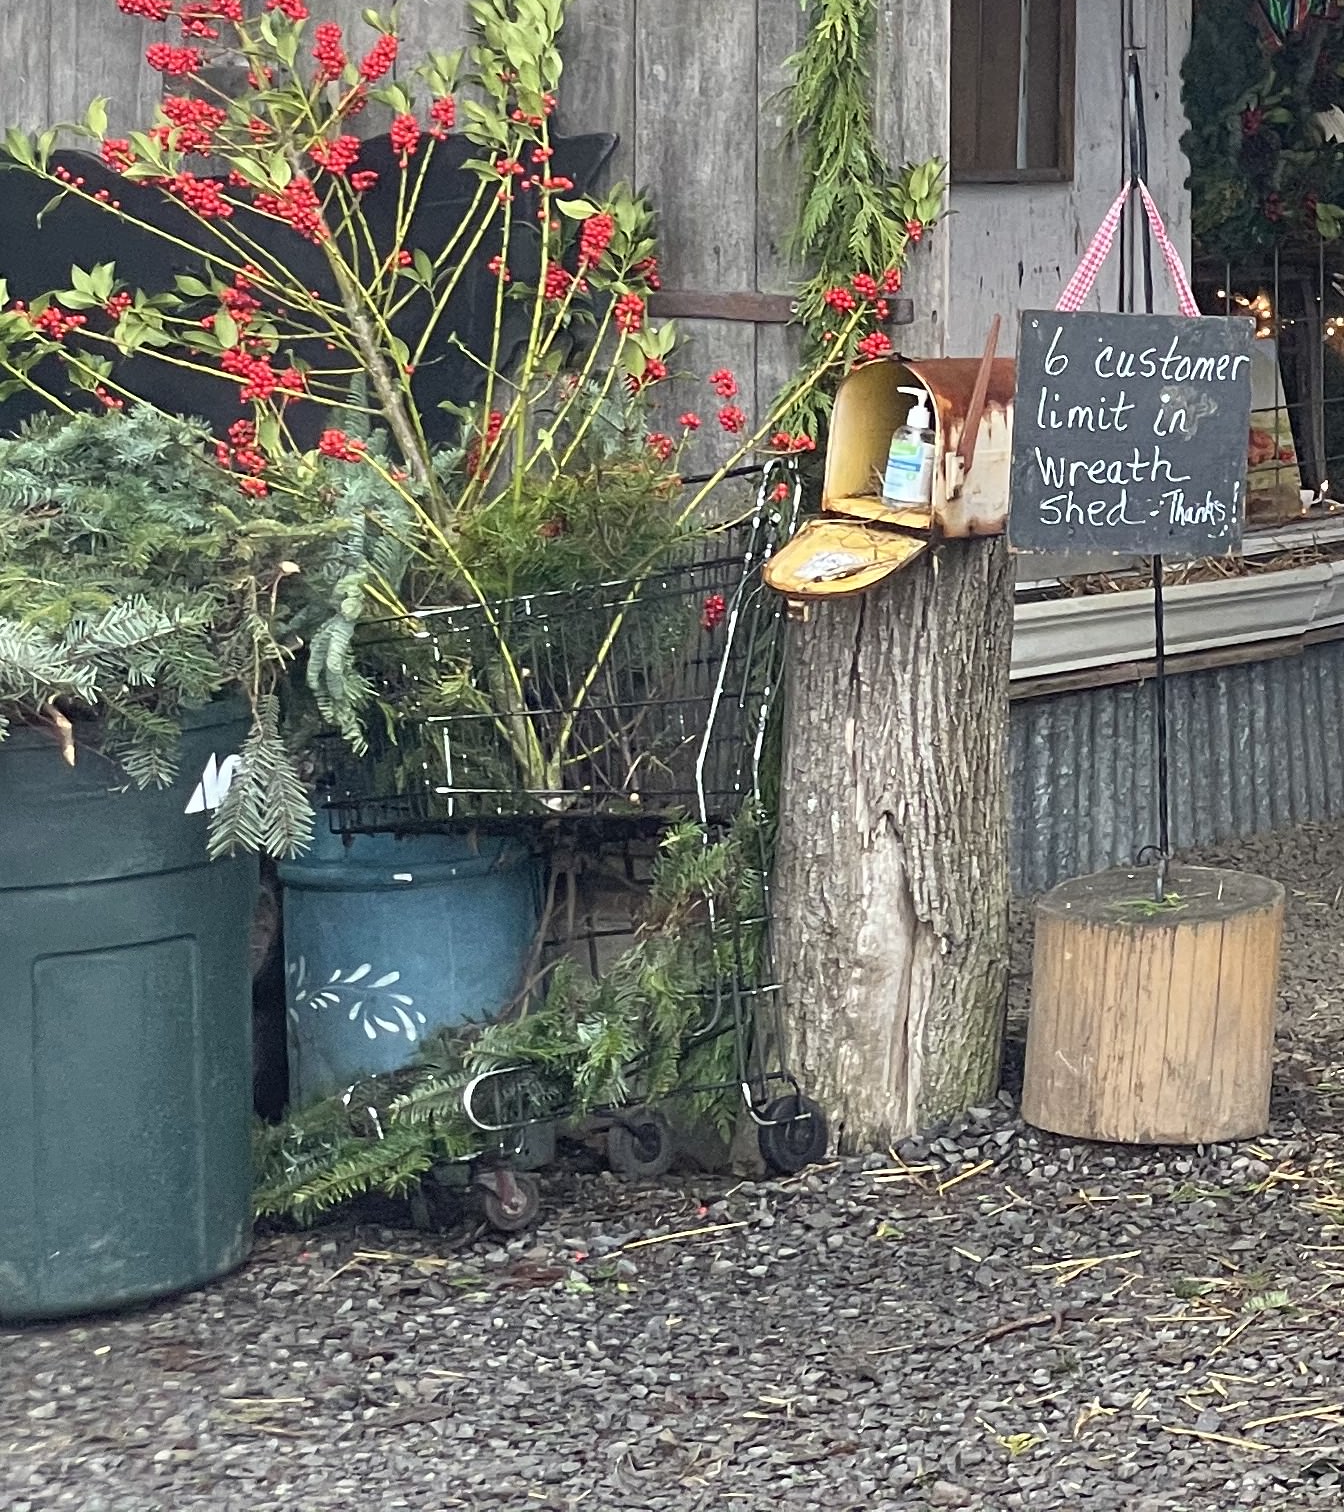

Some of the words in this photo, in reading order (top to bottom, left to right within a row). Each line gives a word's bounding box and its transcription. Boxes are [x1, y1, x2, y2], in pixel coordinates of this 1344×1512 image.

[1044, 326, 1069, 376] 6
[1094, 335, 1250, 382] customer
[1037, 386, 1136, 432] limit
[1153, 393, 1189, 437] in
